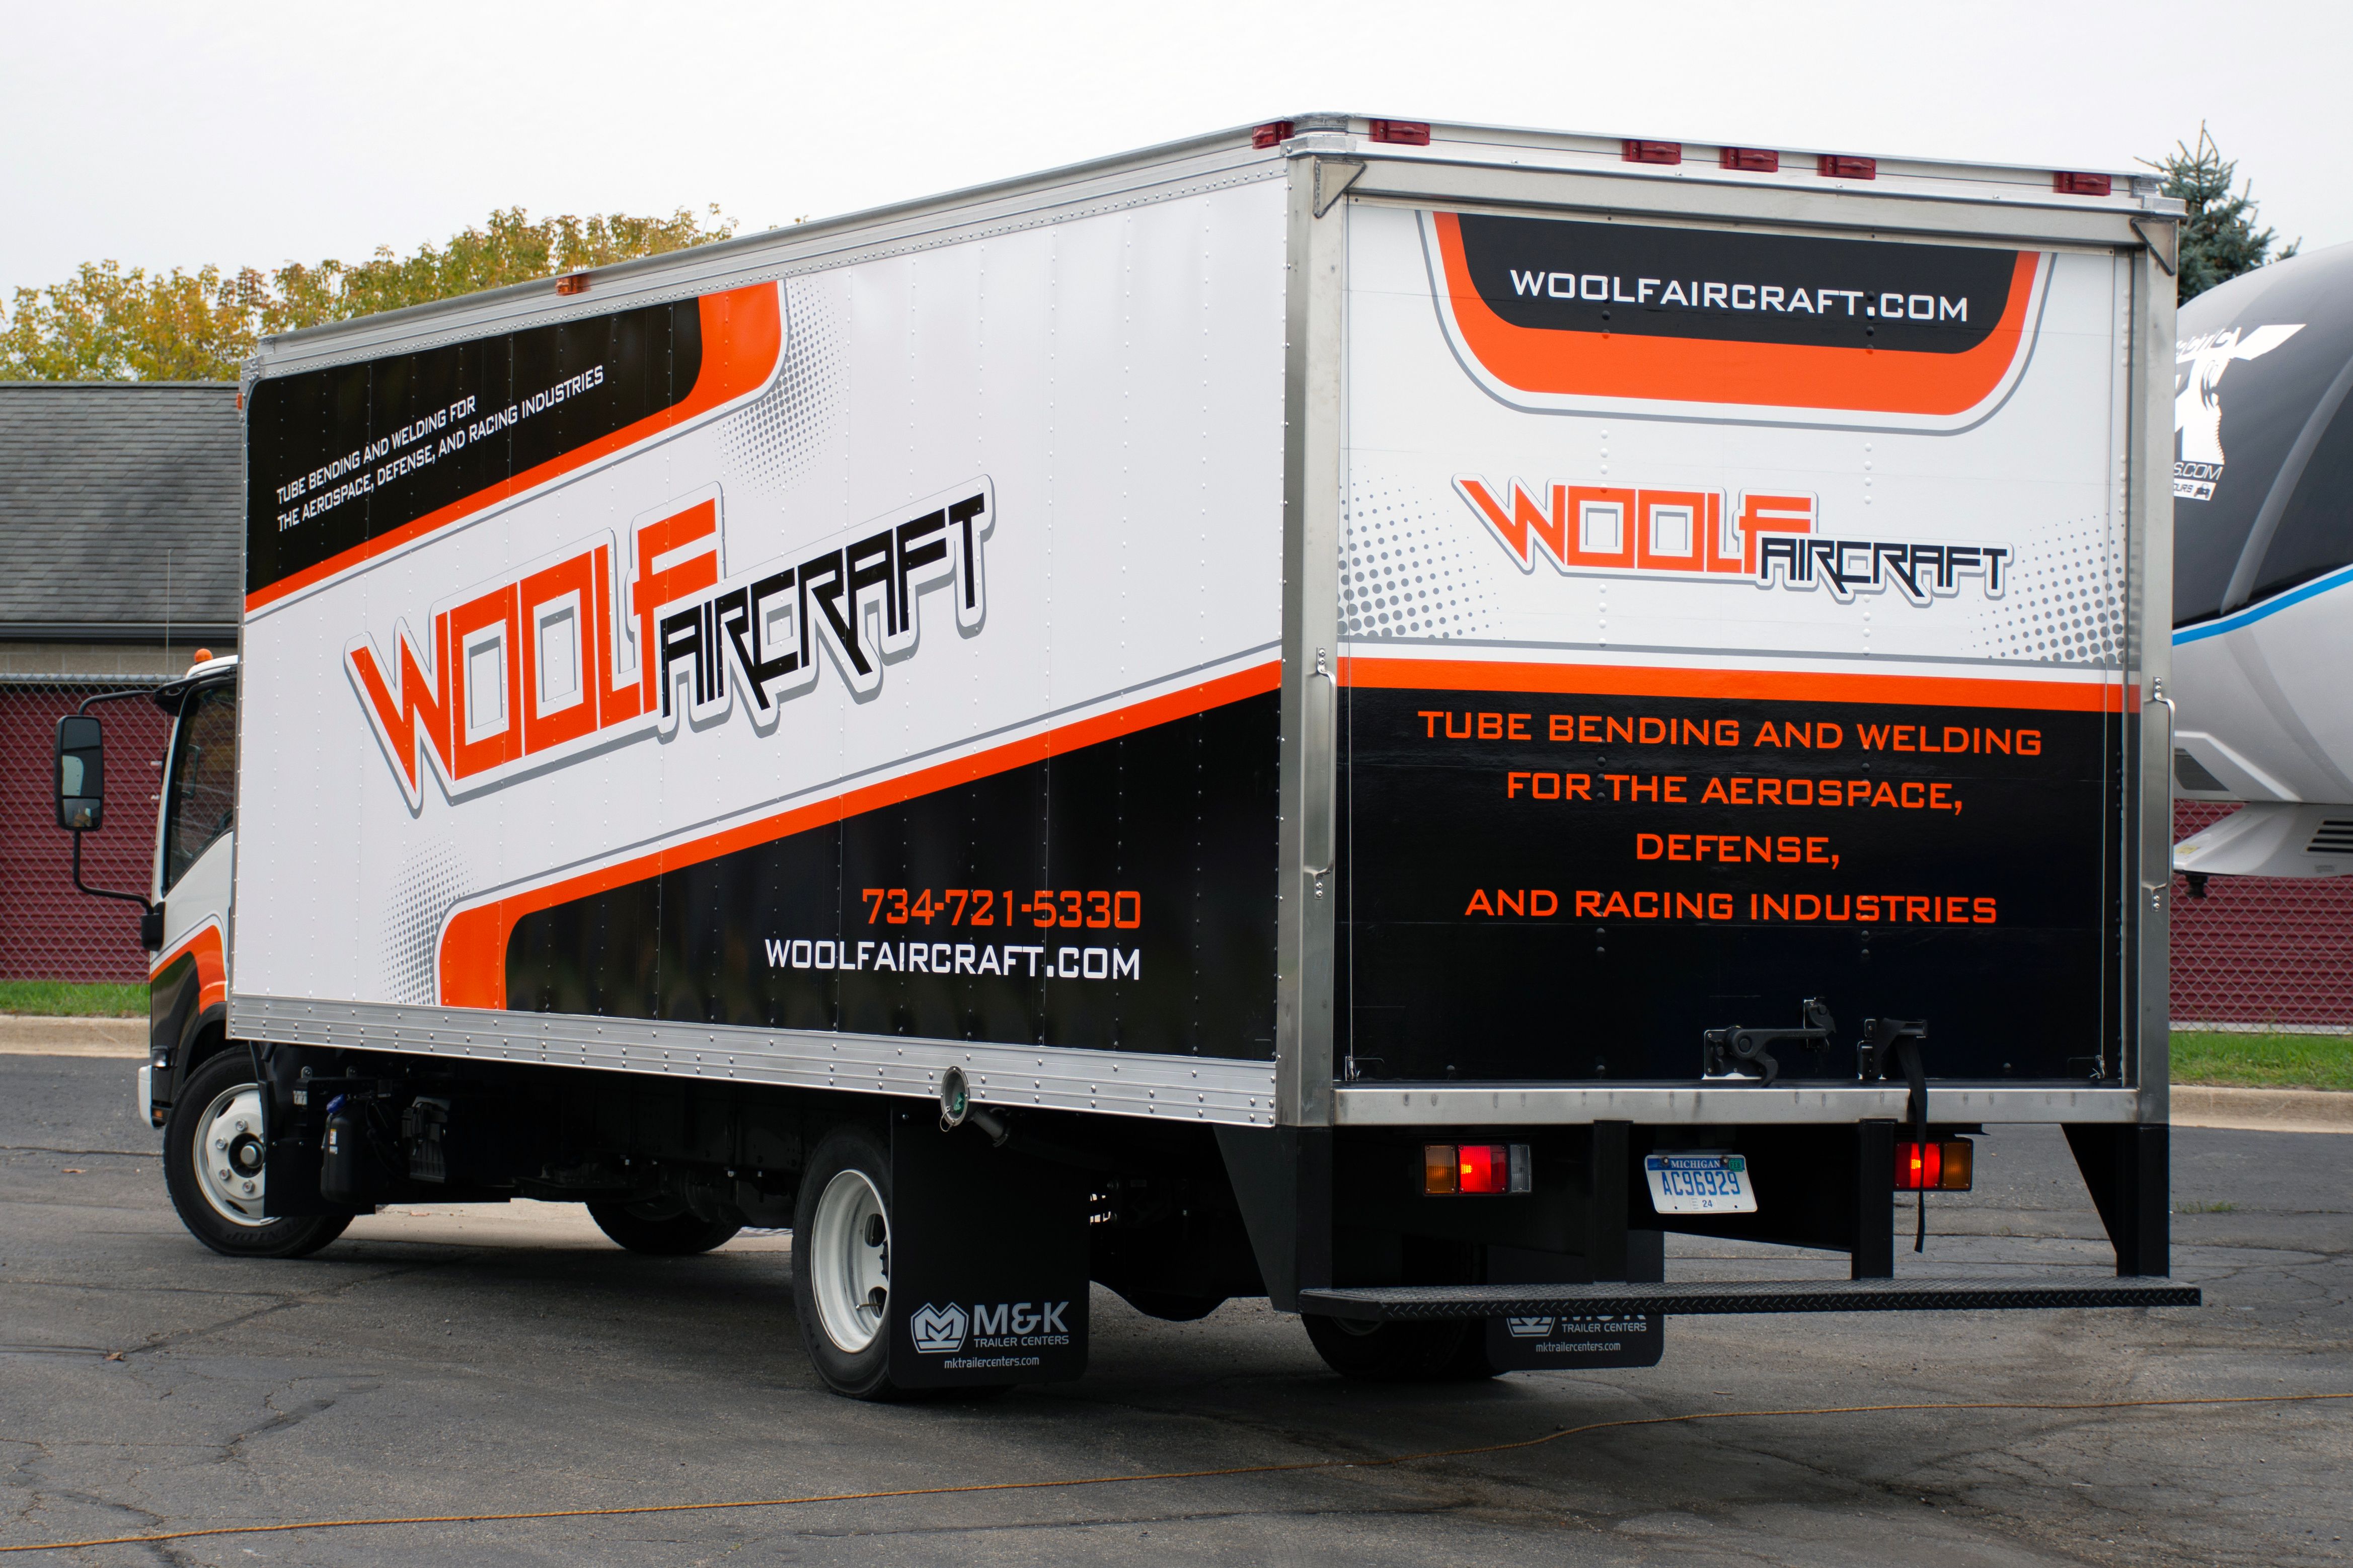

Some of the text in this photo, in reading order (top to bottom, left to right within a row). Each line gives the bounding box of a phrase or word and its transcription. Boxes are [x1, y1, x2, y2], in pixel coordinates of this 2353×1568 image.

[1509, 269, 1967, 323] WOOLFAIRCRAFT.COM
[277, 364, 604, 531] THE AEROSPACE, DEFENSE, AND RACING INDUSTRIES
[277, 395, 476, 504] TUBE BENDING AND WELDING FOR
[1459, 480, 2007, 597] WOOLF AIRCRAFT
[350, 492, 985, 793] WOOLF AIRCRAFT
[1417, 711, 2041, 756] TUBE BENDING AND WELDING
[1507, 771, 1962, 816] FOR THE AEROSPACE,
[1636, 833, 1840, 870] DEFENSE,
[862, 888, 1141, 929] 734-721-5330
[1465, 889, 1997, 923] AND RACING INDUSTRIES
[764, 938, 1140, 981] WOOLFAIRCRAFT.COM
[1671, 1159, 1721, 1168] MICHIGAN
[1729, 1161, 1741, 1169] FEB
[1661, 1171, 1740, 1196] AC96929
[1702, 1199, 1713, 1208] 24
[973, 1301, 1070, 1336] M&K
[1561, 1322, 1647, 1333] TRAILER CENTERS
[973, 1335, 1070, 1348] TRAILER CENTERS
[1536, 1341, 1621, 1353] mktrailercenters.com
[944, 1356, 1040, 1369] mktrailercenters.com
